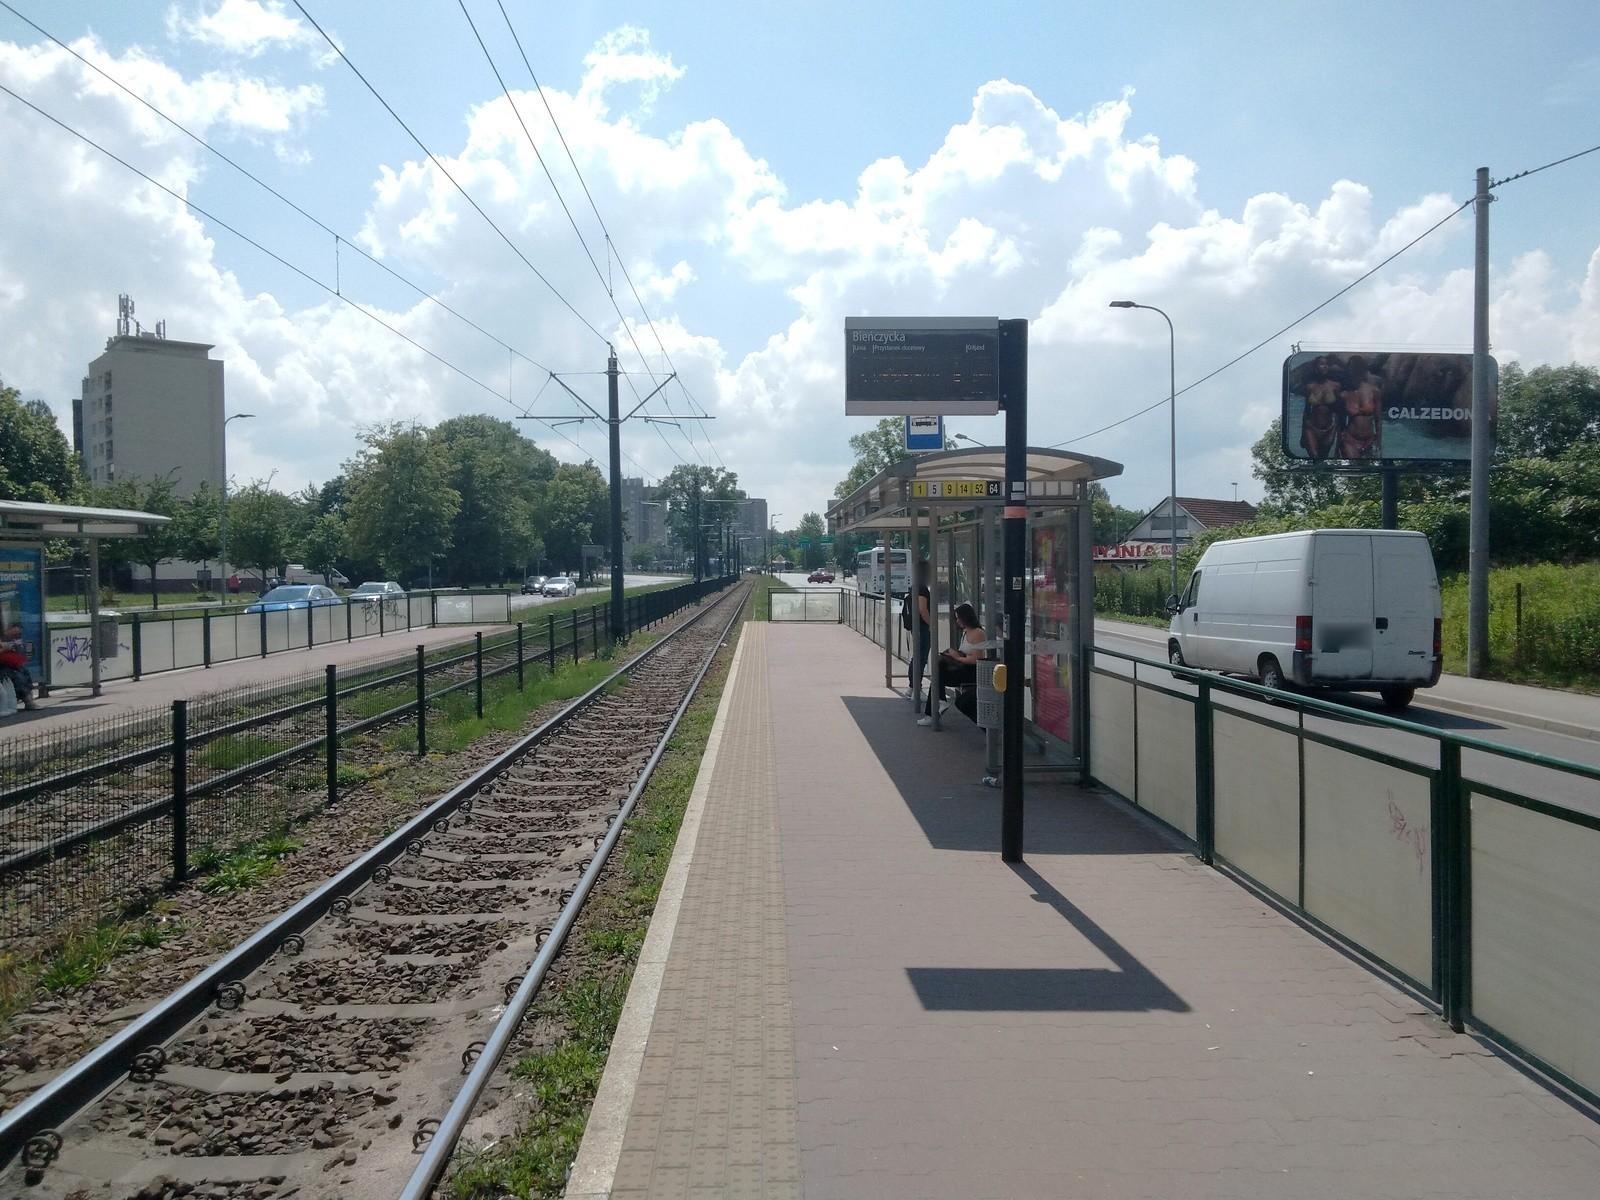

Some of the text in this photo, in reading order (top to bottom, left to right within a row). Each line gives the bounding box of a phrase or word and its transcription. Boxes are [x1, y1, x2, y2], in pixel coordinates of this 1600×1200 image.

[852, 331, 906, 344] Bieńczycka
[1388, 406, 1491, 420] CALZEDON
[932, 484, 937, 494] 5
[947, 484, 952, 494] 9
[960, 484, 968, 494] 14
[975, 484, 984, 494] 52
[989, 483, 998, 494] 64
